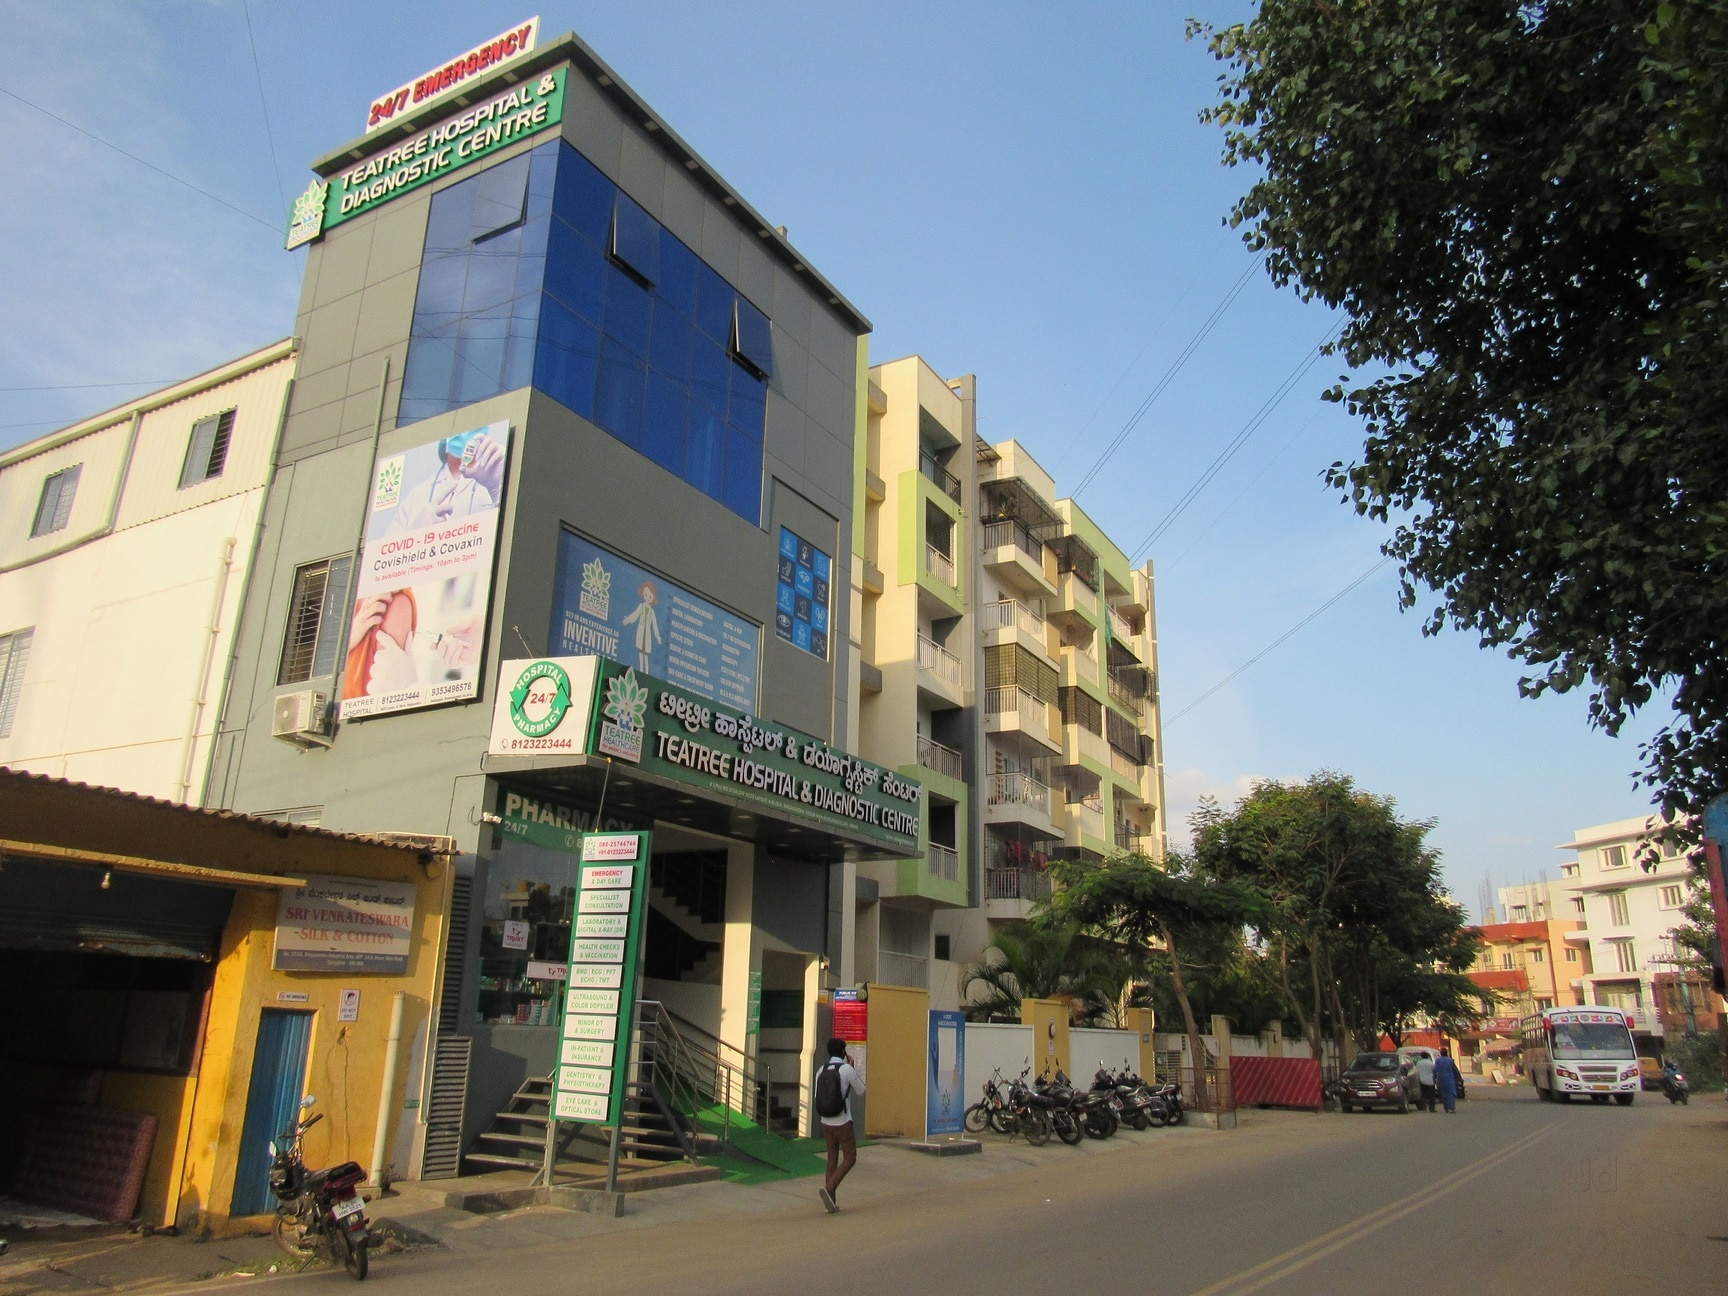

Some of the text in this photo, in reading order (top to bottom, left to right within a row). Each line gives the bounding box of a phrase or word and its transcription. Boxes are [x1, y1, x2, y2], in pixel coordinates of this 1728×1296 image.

[368, 25, 532, 126] 24/7 EMERGENCY
[341, 74, 555, 191] TEATREE HOSPITAL &
[341, 101, 548, 214] DIAGNOSTIC CENTRE
[380, 537, 414, 556] COVID
[424, 532, 435, 545] 19
[438, 523, 480, 541] vaccine
[373, 536, 483, 571] Covishield & Covaxin
[581, 593, 608, 608] TEATREE
[564, 619, 618, 657] INVENTIVE
[516, 664, 562, 690] HOSPITAL
[431, 682, 472, 697] 9353496578
[344, 698, 374, 709] TEATREE
[381, 691, 420, 705] 8123223444
[530, 693, 556, 704] 24/7
[343, 708, 373, 718] HOSPITAL
[513, 707, 561, 734] PHARMACY
[605, 724, 641, 746] TEATREE
[511, 738, 572, 750] 8123223444
[603, 735, 640, 754] HEALTHCARE
[785, 736, 798, 759] &
[657, 730, 730, 779] TEATREE
[732, 756, 799, 801] HOSPITAL
[800, 780, 813, 804] &
[814, 783, 880, 825] DIAGNOSTIC
[881, 807, 919, 838] CENTRE
[504, 820, 528, 835] 24/7
[585, 902, 623, 910] CONSULTATION
[286, 906, 409, 928] SRI VENKATESWARA
[582, 918, 616, 926] LABORATORY
[300, 927, 394, 945] SILK & COTTON
[585, 952, 618, 960] VACCINATION
[573, 993, 607, 1001] ULTRASOUND
[577, 1019, 595, 1027] MINOR
[580, 1028, 605, 1036] SURGERY
[570, 1045, 599, 1054] IN-PATIENT
[571, 1054, 602, 1063] INSURANCE
[566, 1071, 596, 1080] DENTISTRY
[563, 1080, 606, 1090] PHYSIOTHERAPY
[560, 1106, 602, 1117] OPTICAL STORE
